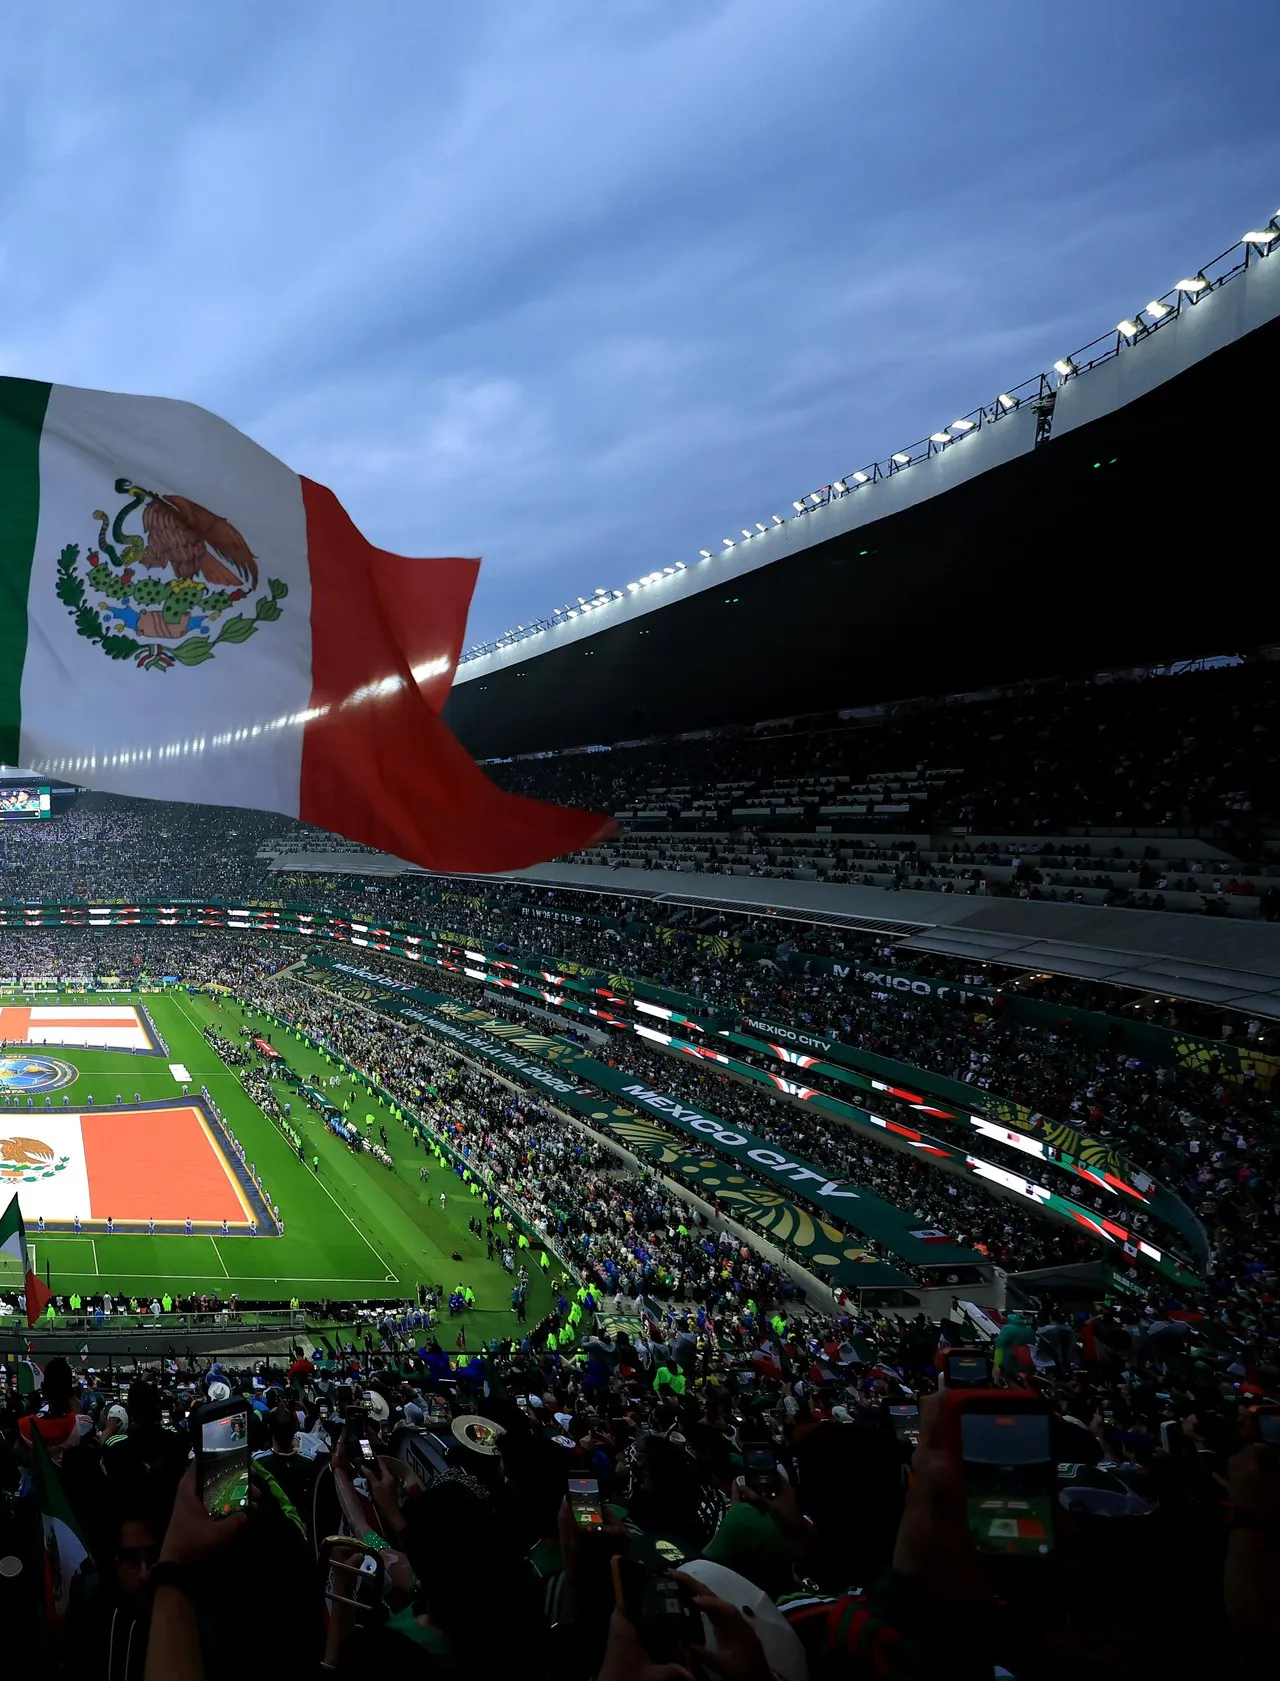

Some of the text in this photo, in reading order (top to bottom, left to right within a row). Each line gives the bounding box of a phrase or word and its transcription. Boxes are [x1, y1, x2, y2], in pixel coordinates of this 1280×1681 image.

[332, 964, 380, 980] MEXICO
[833, 965, 932, 995] MXICO
[400, 1008, 576, 1092] COPA MUNDIAL DE LA FIFA 2026
[748, 1020, 831, 1052] MEXICO CITY
[621, 1084, 860, 1198] MEXICO CITY
